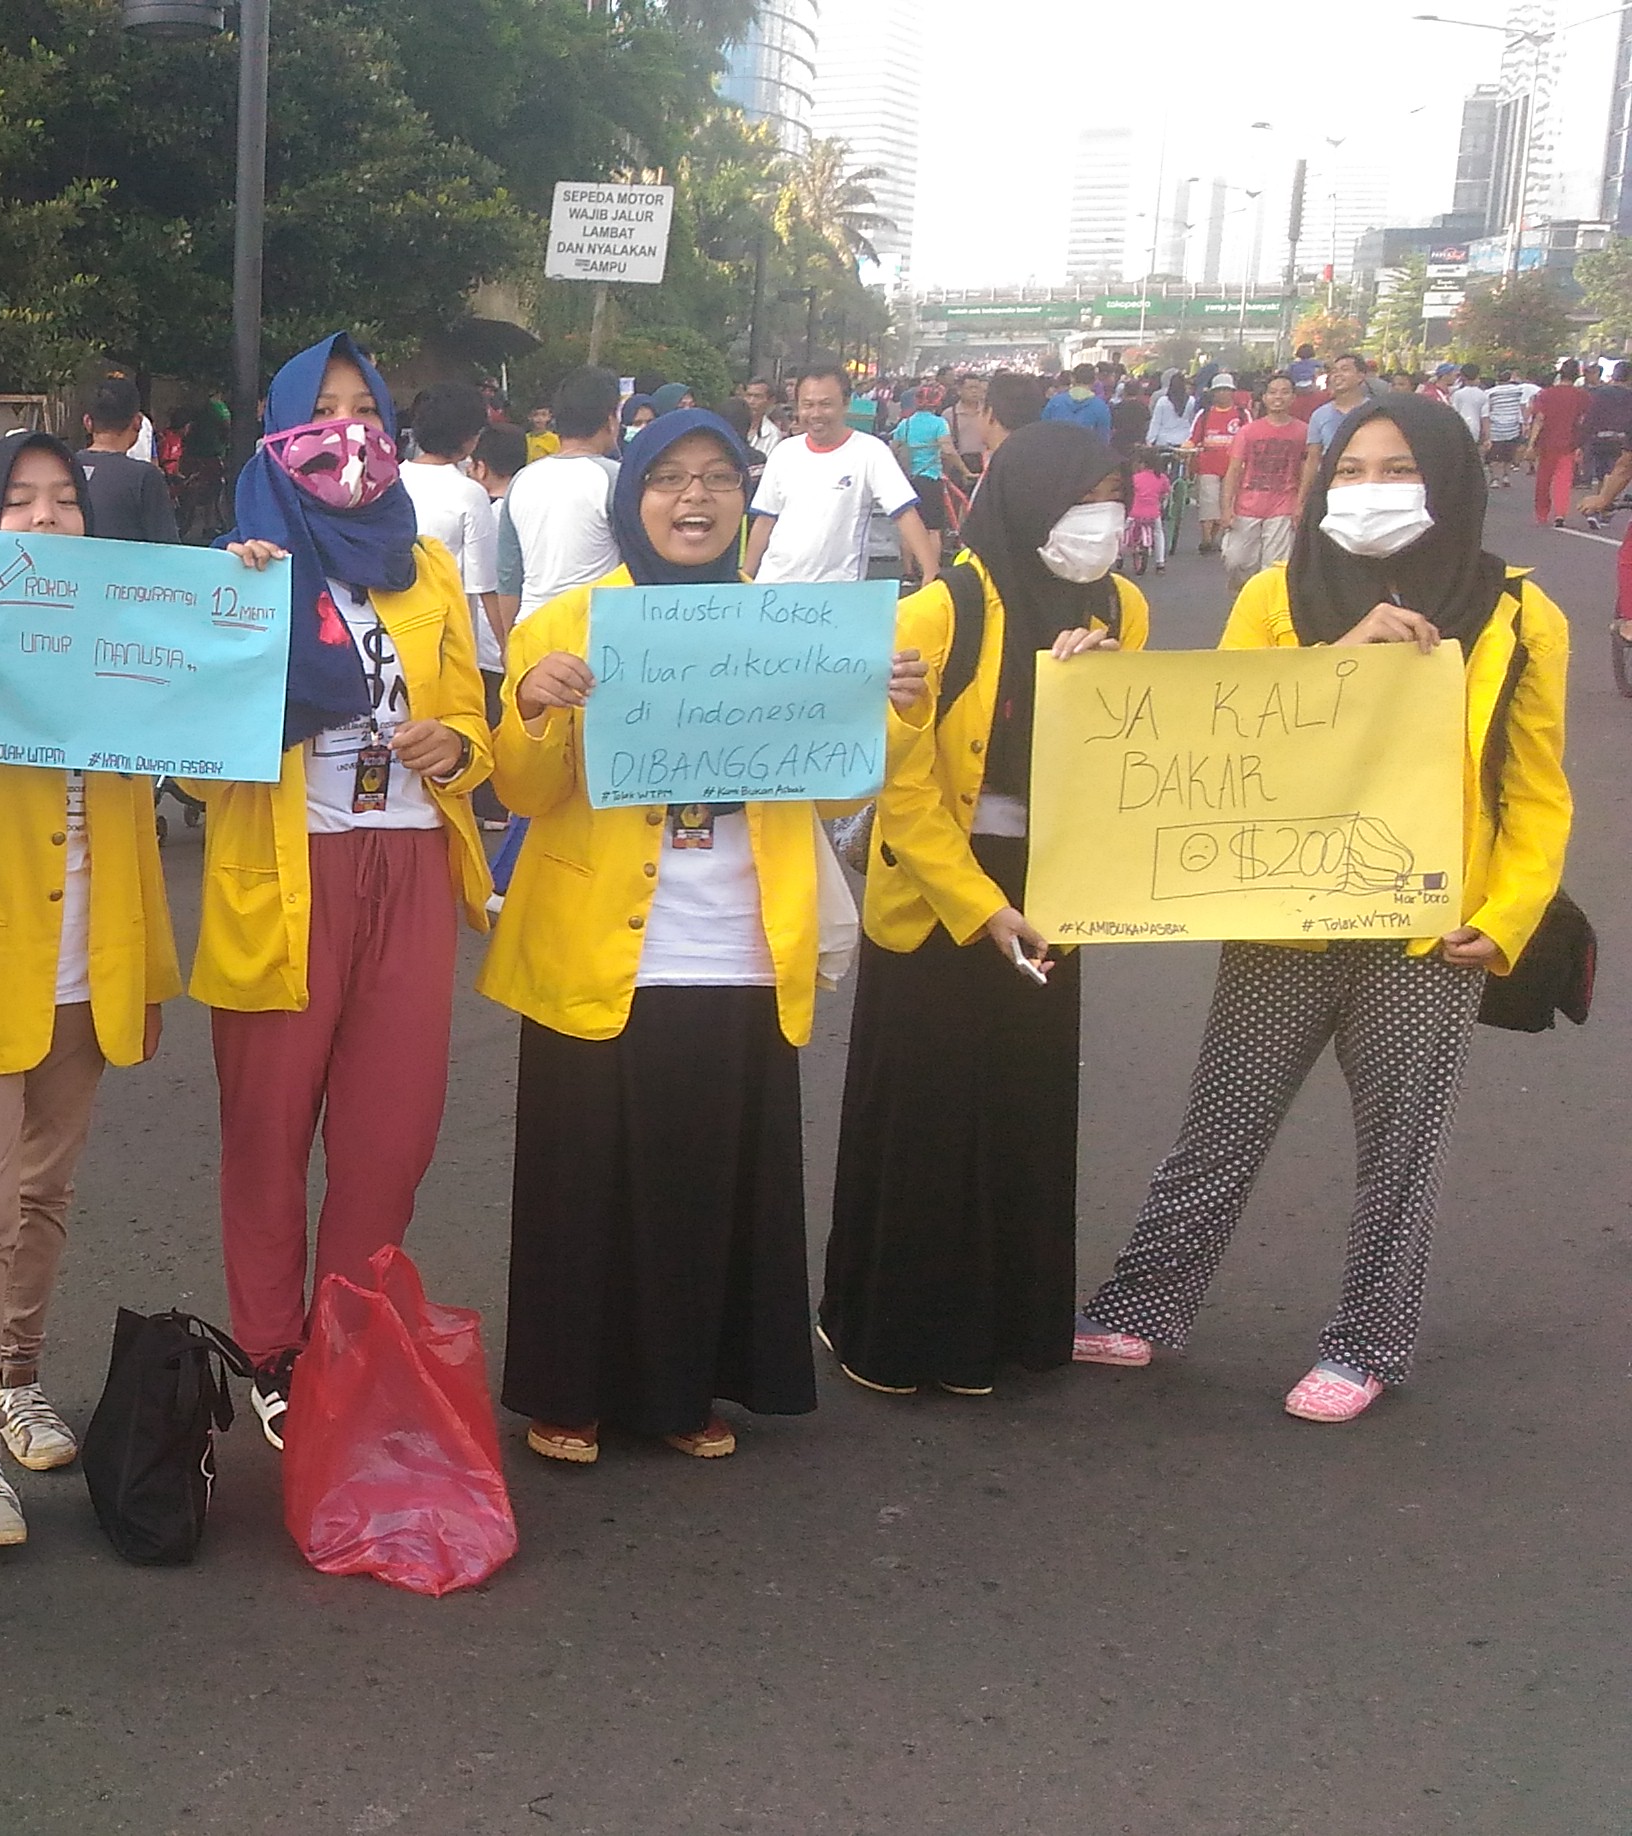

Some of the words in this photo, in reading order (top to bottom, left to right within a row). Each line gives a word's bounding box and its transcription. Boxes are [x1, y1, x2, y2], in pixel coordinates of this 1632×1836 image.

[563, 190, 614, 204] SEPEDA
[616, 192, 665, 206] MOTOR
[569, 207, 608, 220] WAJIB
[611, 210, 654, 223] JALUR
[582, 225, 635, 239] LAMBAT
[556, 241, 585, 254] DAN
[587, 243, 657, 257] NYALAKAN
[1106, 300, 1152, 310] tokopeda
[24, 576, 78, 598] ROKOK
[211, 586, 238, 618] 12
[239, 607, 277, 621] MENIT
[642, 593, 741, 622] Industri
[20, 631, 72, 654] UMUR
[600, 645, 624, 684] Di
[641, 648, 697, 684] luar
[625, 700, 651, 725] di
[676, 698, 826, 728] Indonesia
[1084, 685, 1159, 744] YA
[610, 737, 878, 788] DIBANGGAKAN
[1118, 750, 1278, 814] BAKAR
